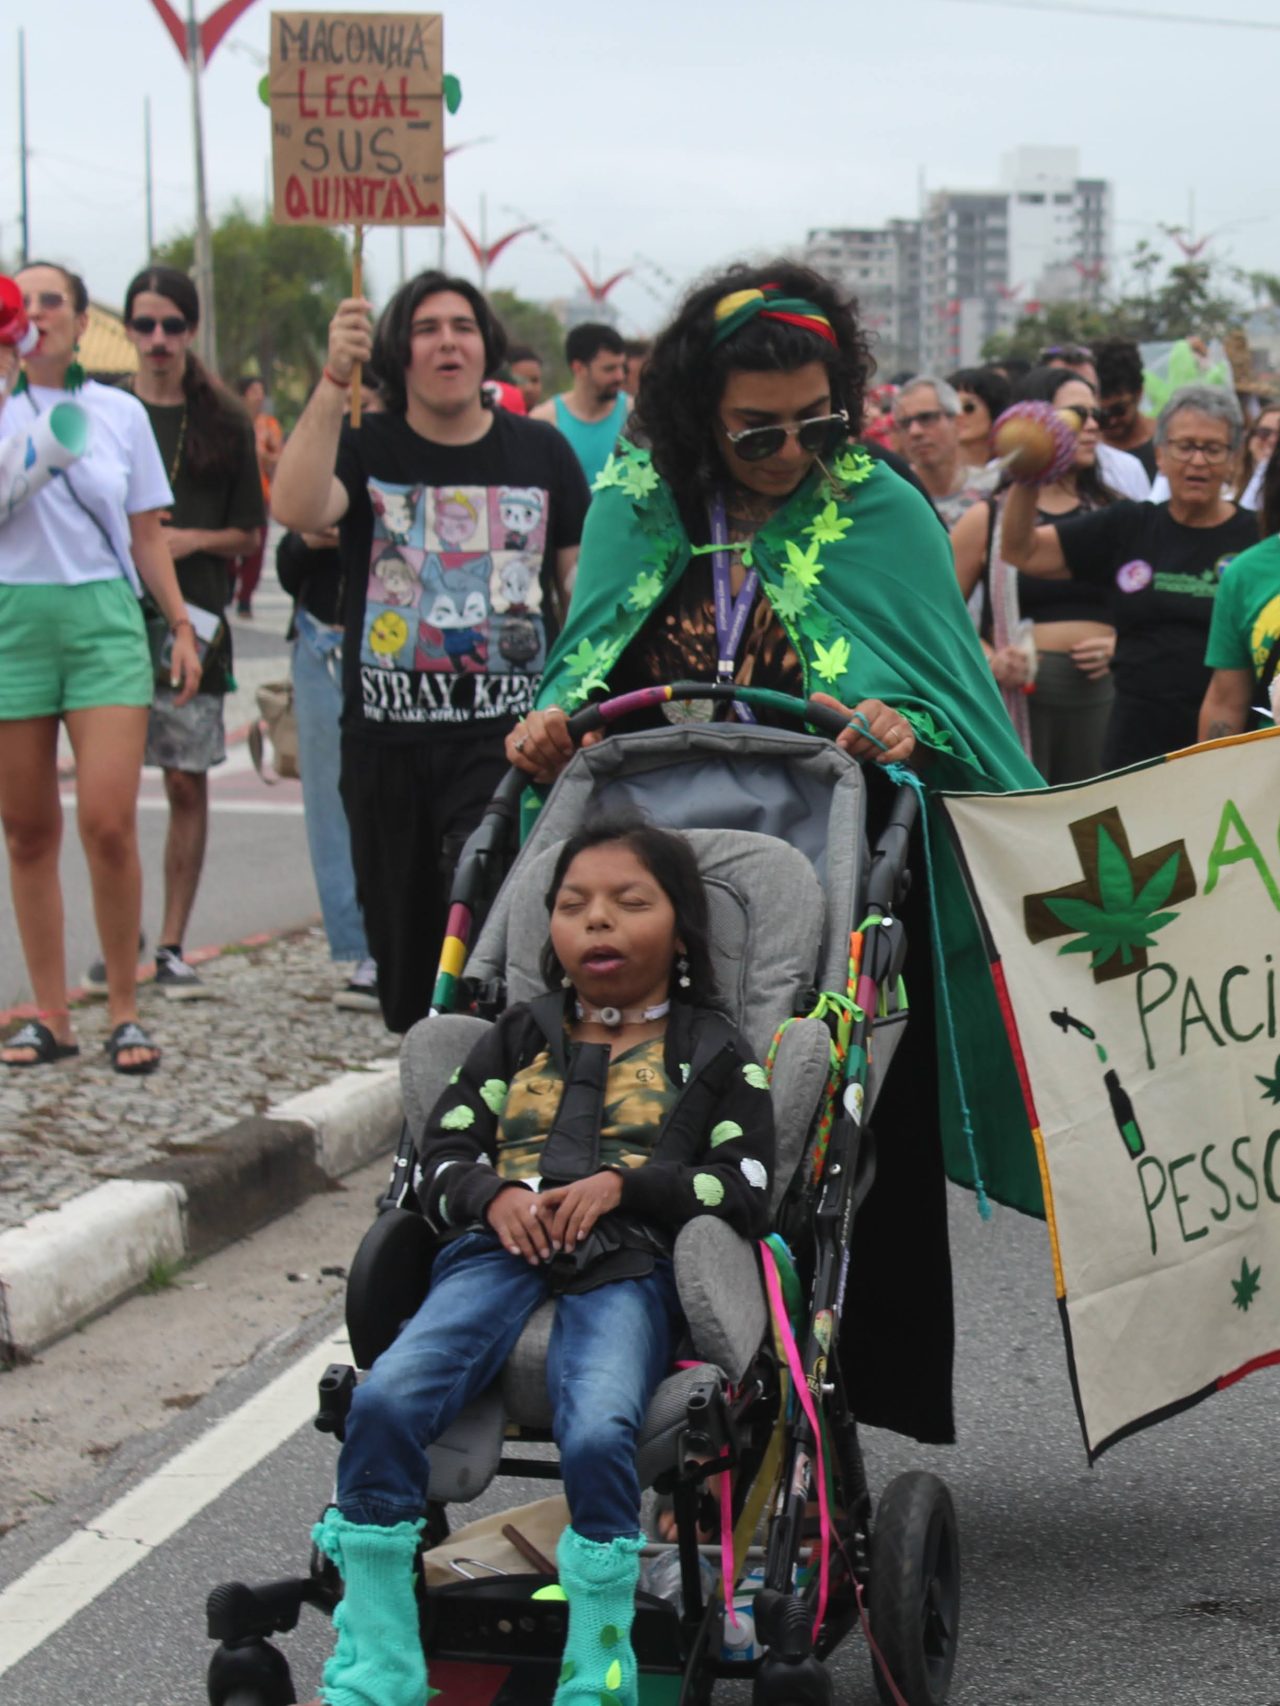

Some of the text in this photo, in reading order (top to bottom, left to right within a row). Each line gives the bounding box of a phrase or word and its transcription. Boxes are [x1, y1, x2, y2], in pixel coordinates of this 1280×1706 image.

[279, 16, 428, 71] MACONHA
[297, 67, 421, 120] LEGAL
[301, 126, 404, 175] SUS
[284, 172, 441, 219] QUINTAL
[360, 666, 460, 711] STRAY
